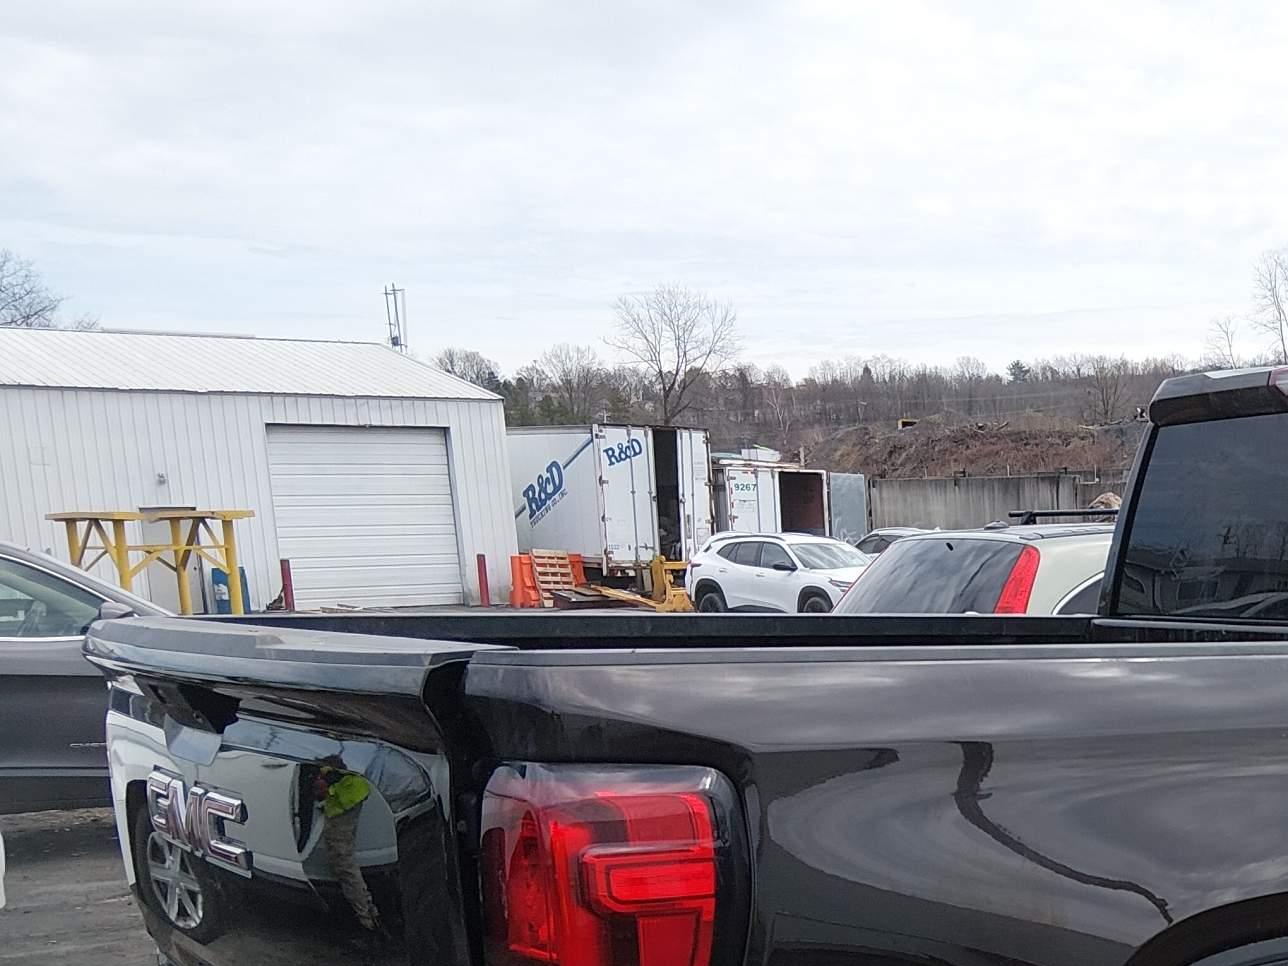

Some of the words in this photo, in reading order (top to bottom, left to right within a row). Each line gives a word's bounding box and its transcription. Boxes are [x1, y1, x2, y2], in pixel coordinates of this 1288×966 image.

[603, 438, 643, 466] R&D
[523, 460, 563, 520] R&D
[734, 483, 757, 491] 9267
[147, 770, 252, 873] GMC
